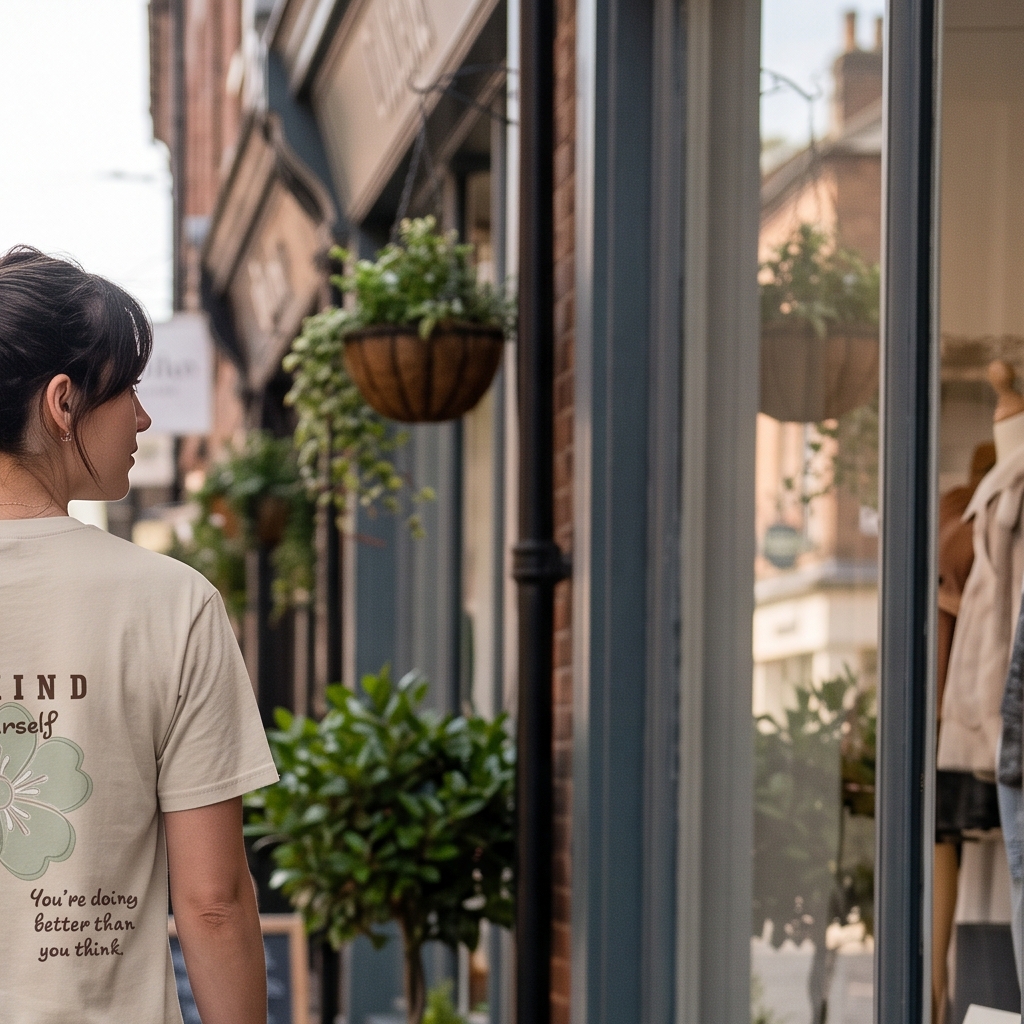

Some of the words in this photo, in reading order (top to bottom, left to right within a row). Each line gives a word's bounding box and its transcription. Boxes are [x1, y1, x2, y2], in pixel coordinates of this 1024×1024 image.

[30, 888, 87, 908] You're
[90, 888, 138, 909] doing
[34, 912, 90, 933] better
[93, 912, 136, 932] than
[37, 945, 70, 962] you
[74, 937, 124, 957] think.
